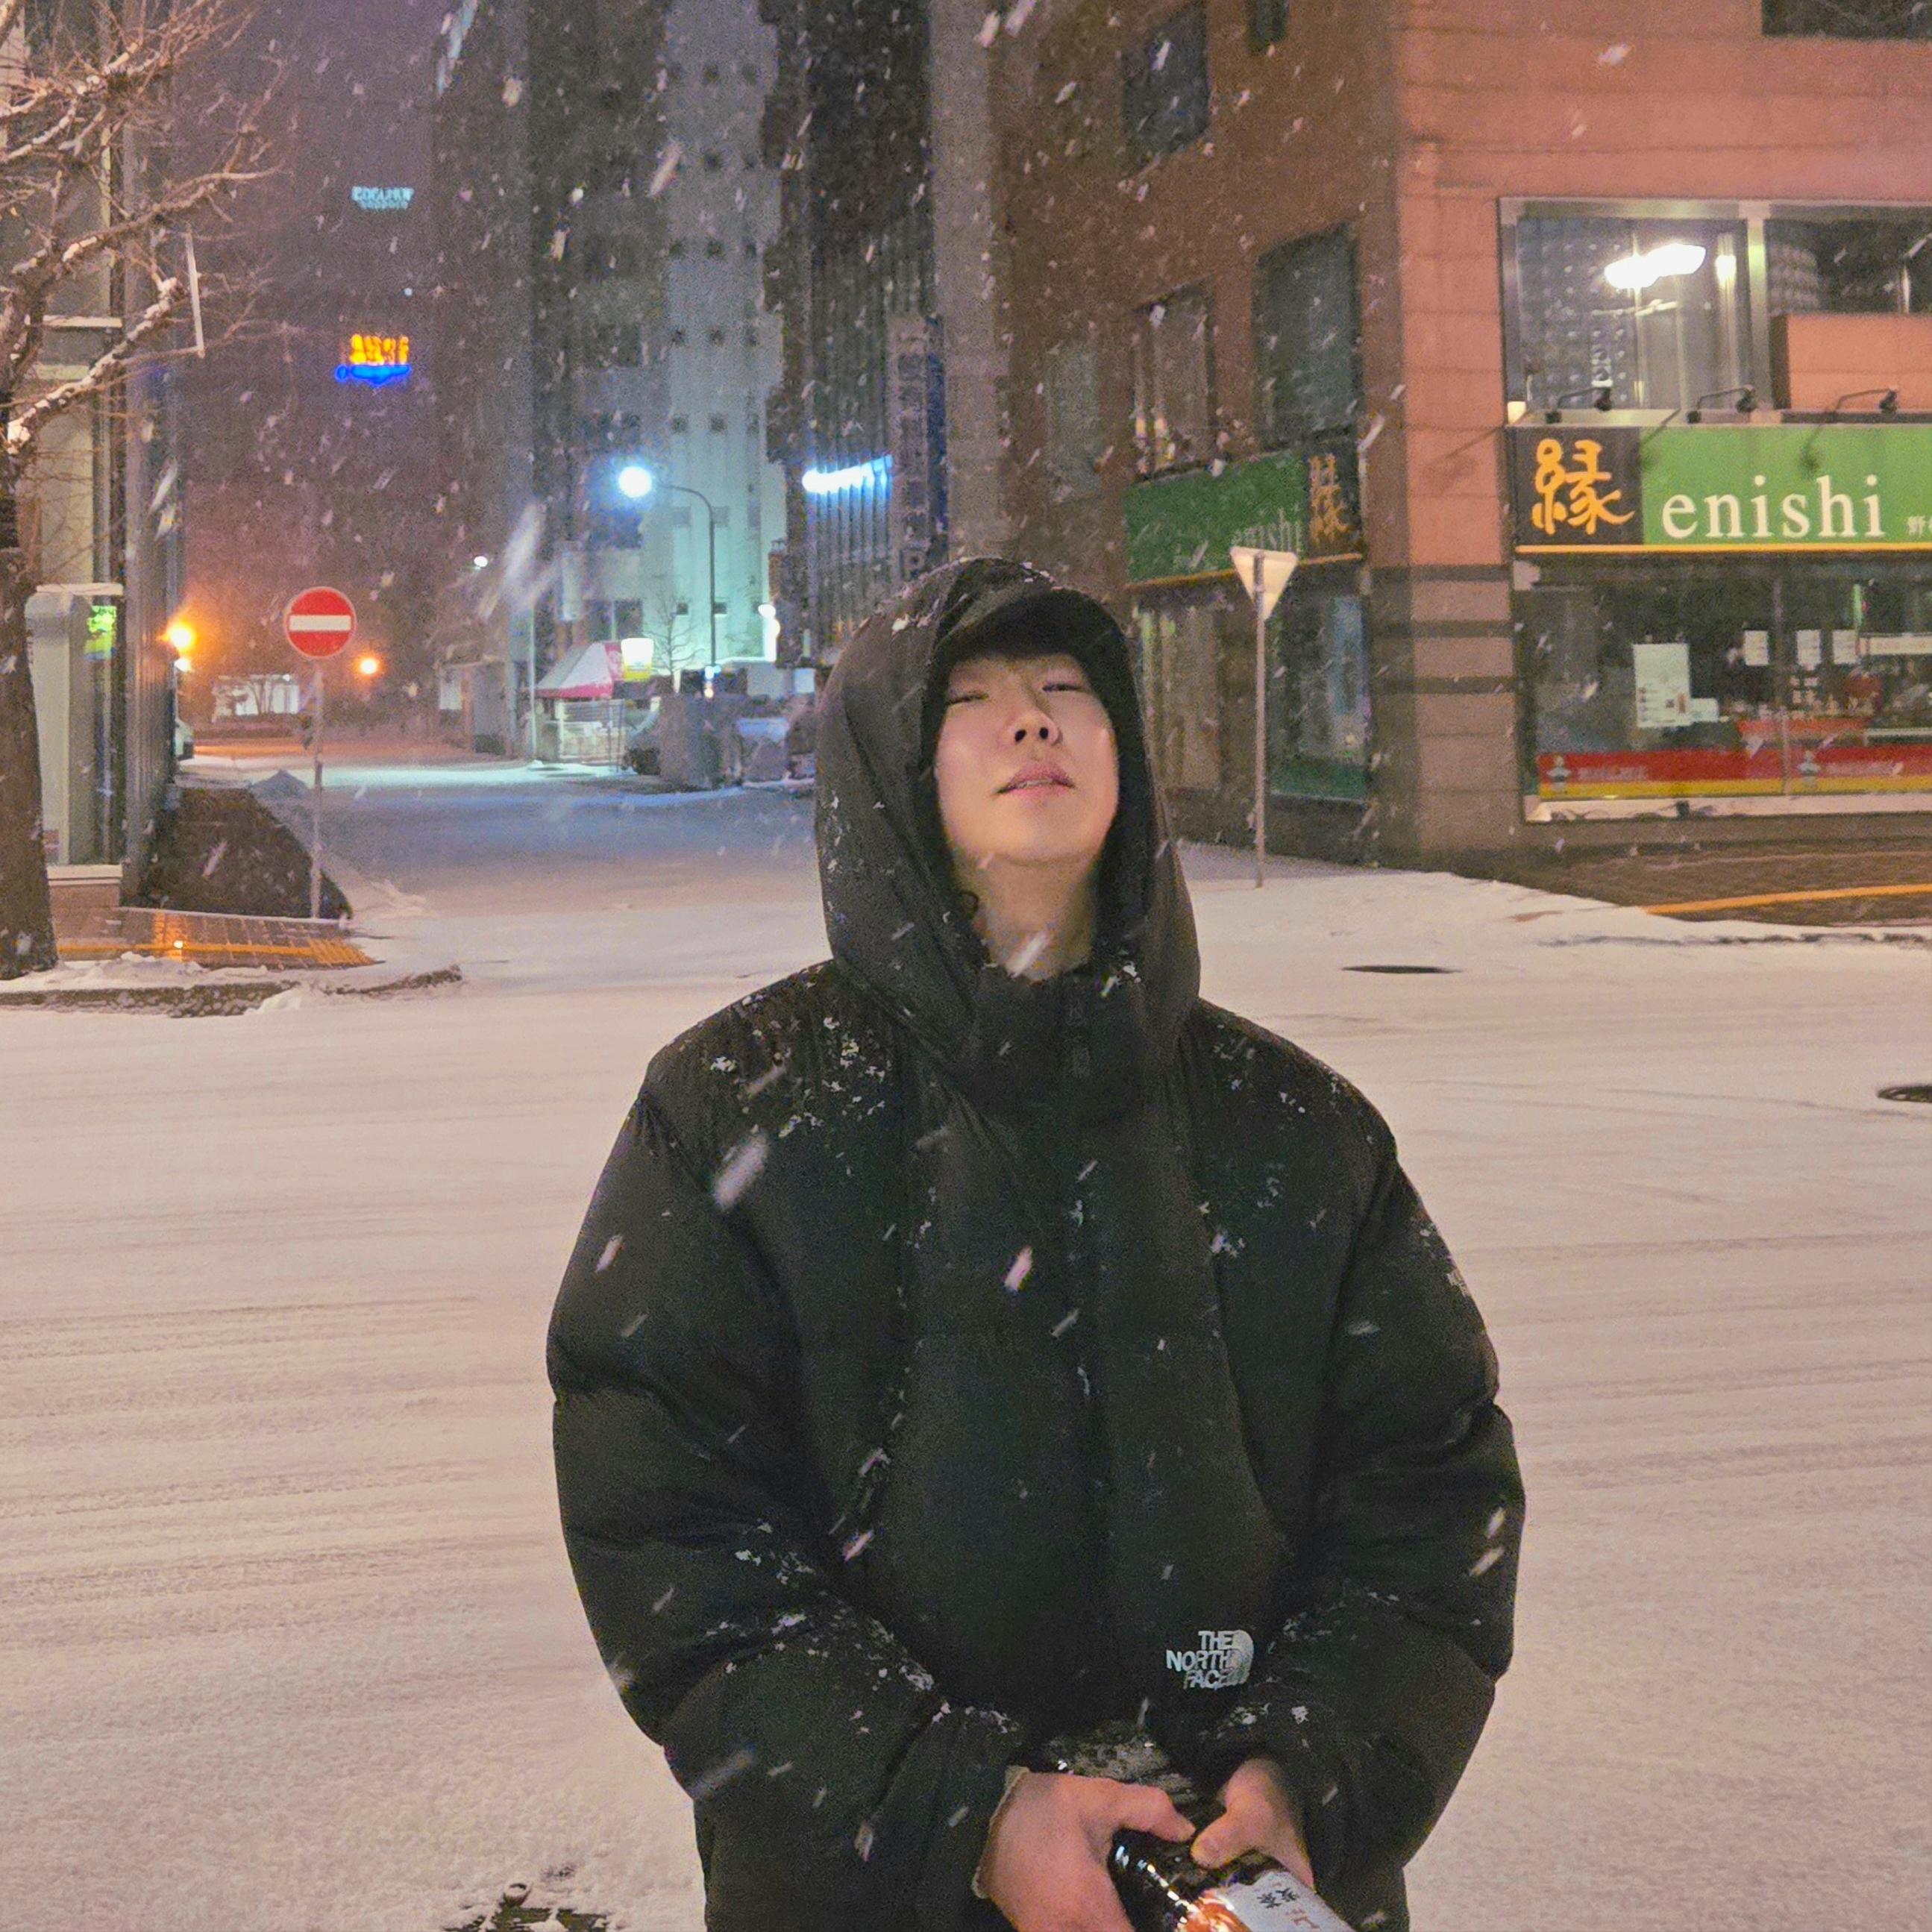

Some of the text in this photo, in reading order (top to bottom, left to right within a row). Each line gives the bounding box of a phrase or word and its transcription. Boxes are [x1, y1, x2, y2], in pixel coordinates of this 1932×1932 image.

[1662, 475, 1886, 539] enishi
[1198, 1631, 1235, 1650] THE
[1166, 1649, 1232, 1672] NORTH
[1183, 1669, 1228, 1690] FACE
